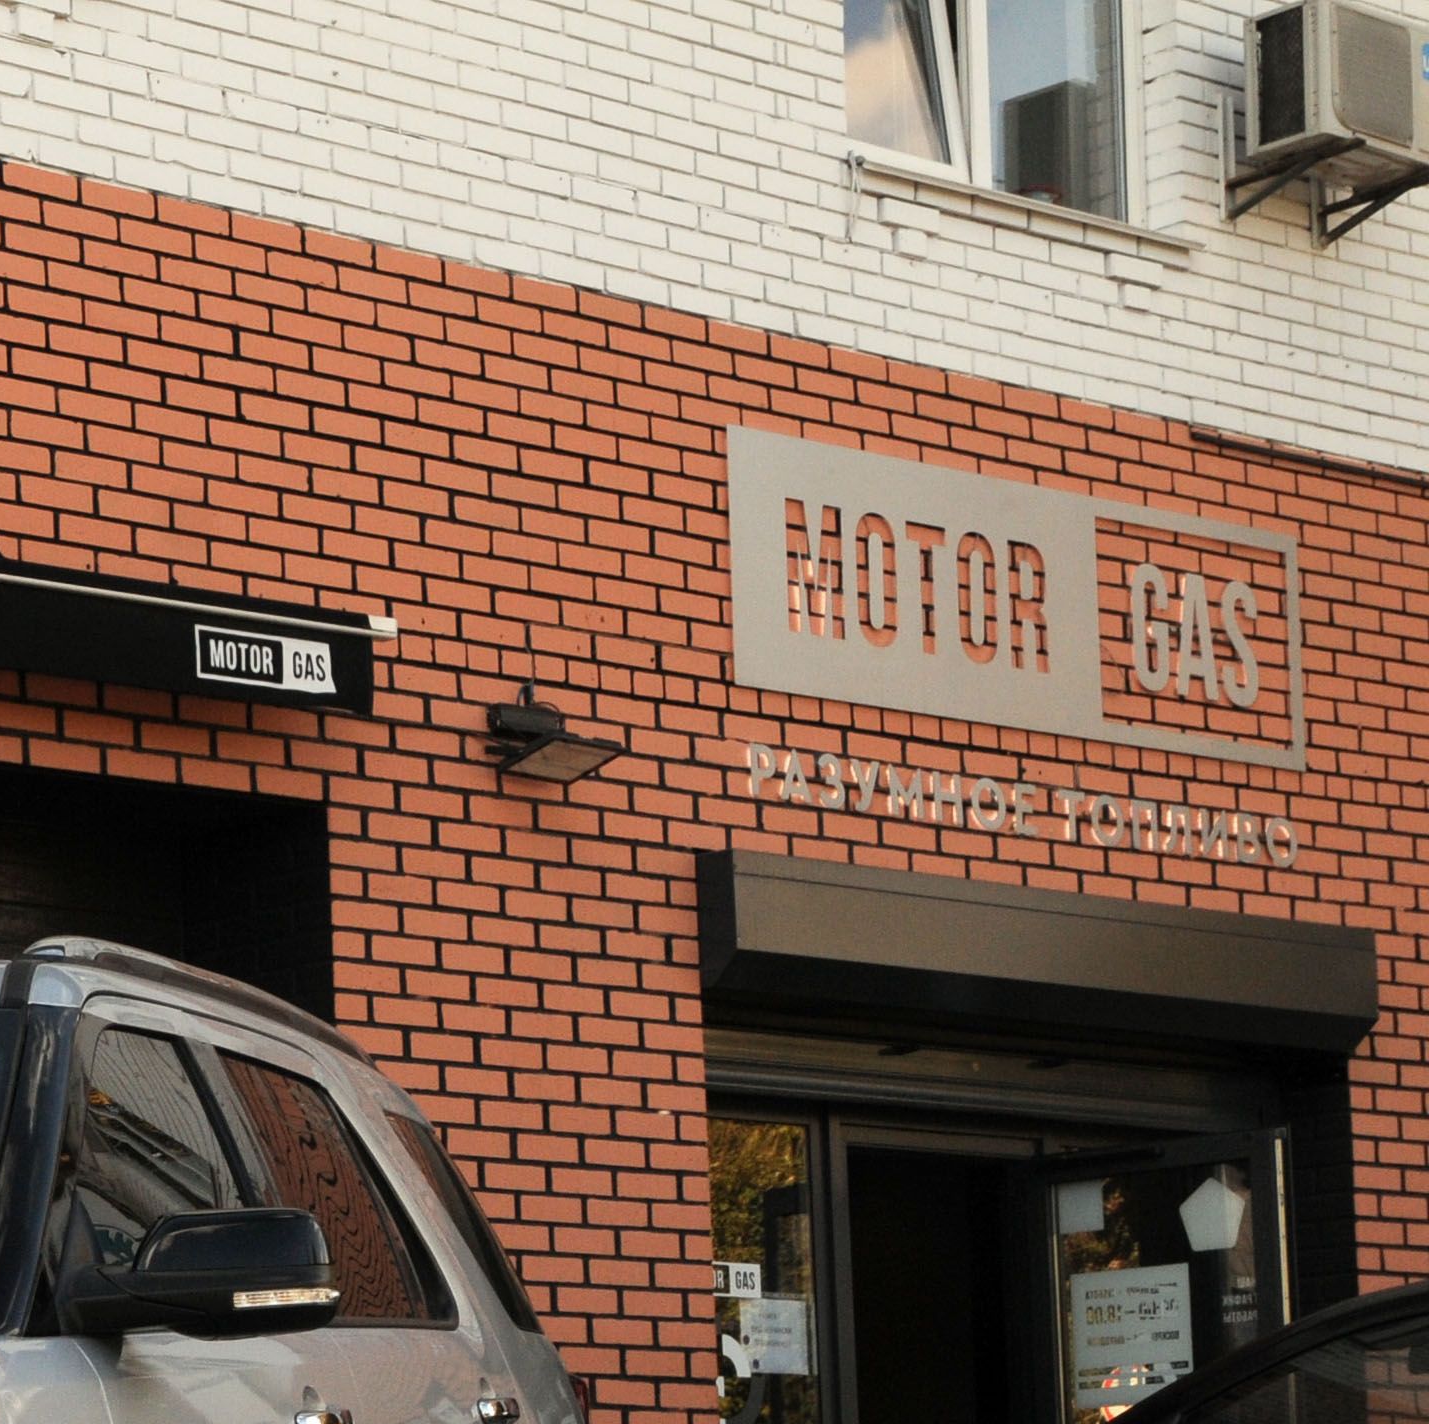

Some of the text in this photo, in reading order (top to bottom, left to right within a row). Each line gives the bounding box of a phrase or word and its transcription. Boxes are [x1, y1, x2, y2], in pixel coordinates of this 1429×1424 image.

[783, 496, 1260, 709] MOTOR GAS
[208, 638, 326, 682] MOTOR GAS
[746, 741, 1300, 869] РАЗУМНОЕ ТОПЛИВО
[735, 1271, 756, 1290] GAS
